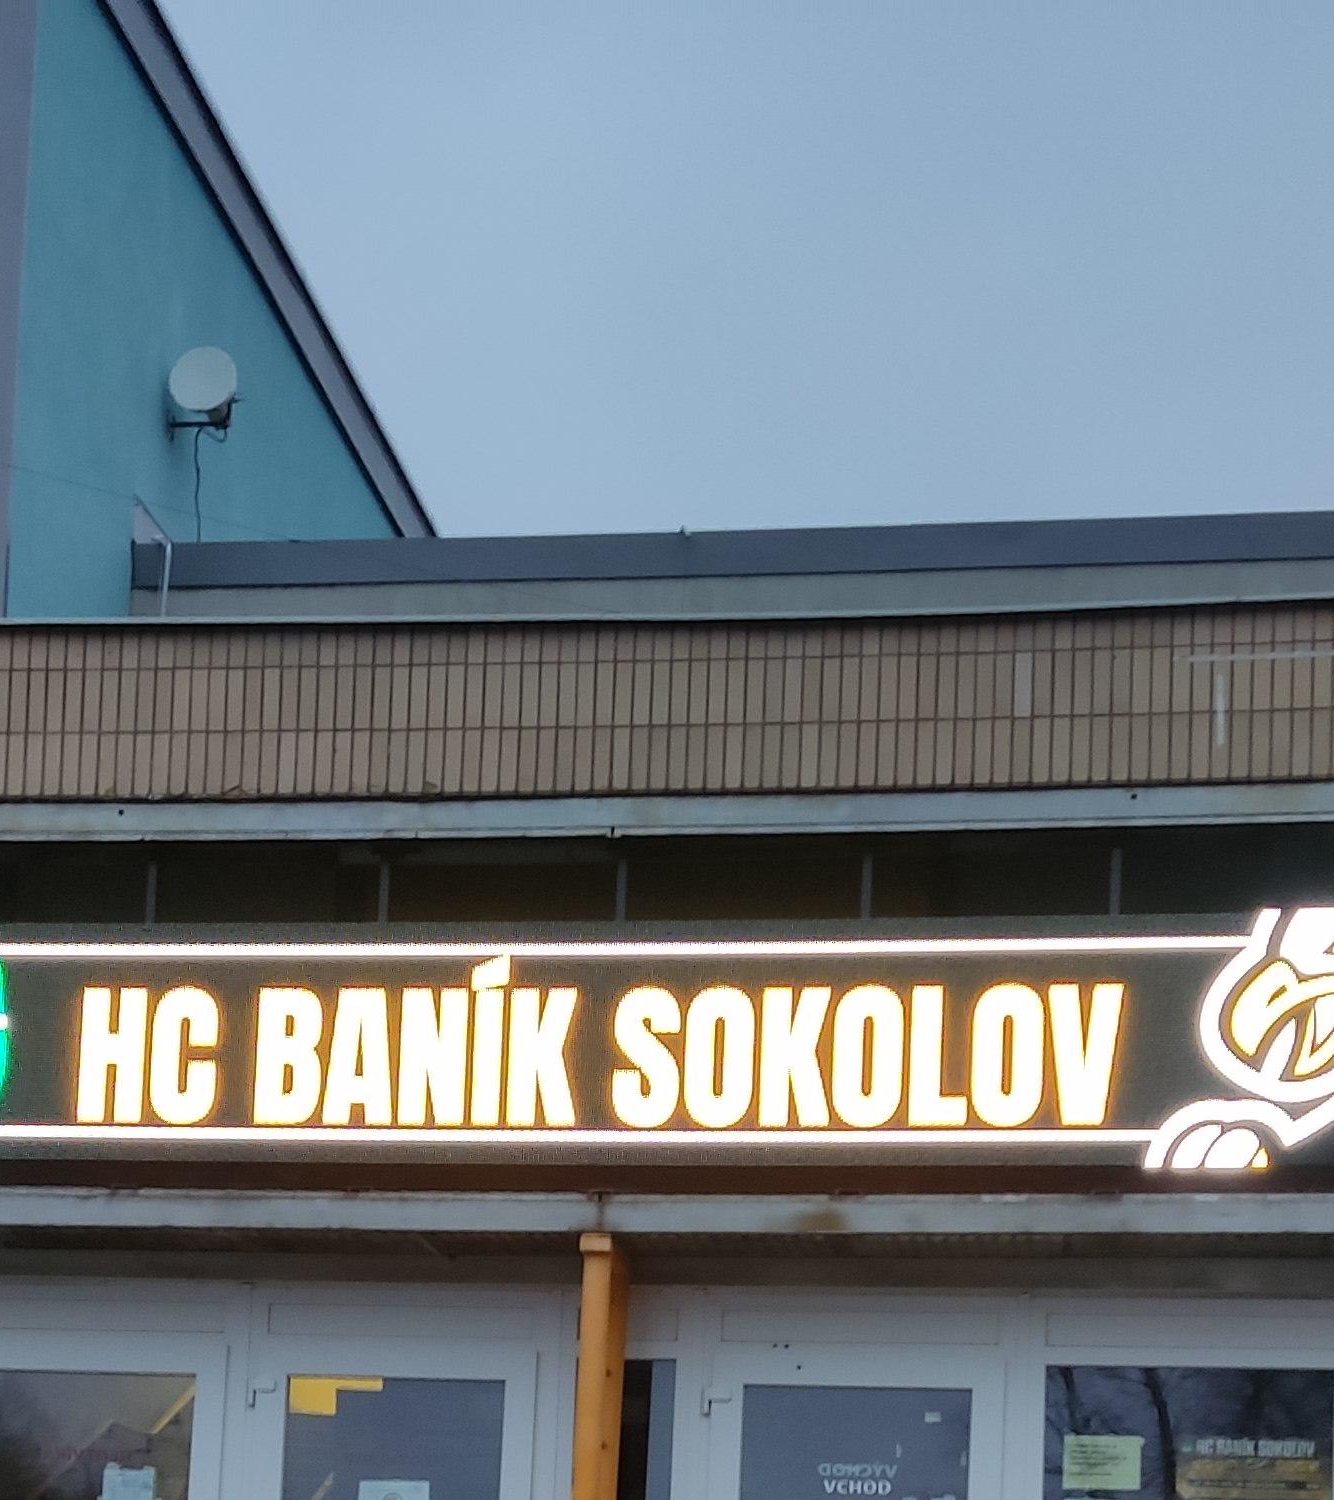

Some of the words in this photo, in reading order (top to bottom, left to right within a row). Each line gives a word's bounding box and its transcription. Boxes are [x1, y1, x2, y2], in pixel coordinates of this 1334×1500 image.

[74, 984, 220, 1126] HC
[252, 953, 578, 1127] BANÍK
[611, 981, 1126, 1130] SOKOLOV
[823, 1479, 892, 1495] VCHOD
